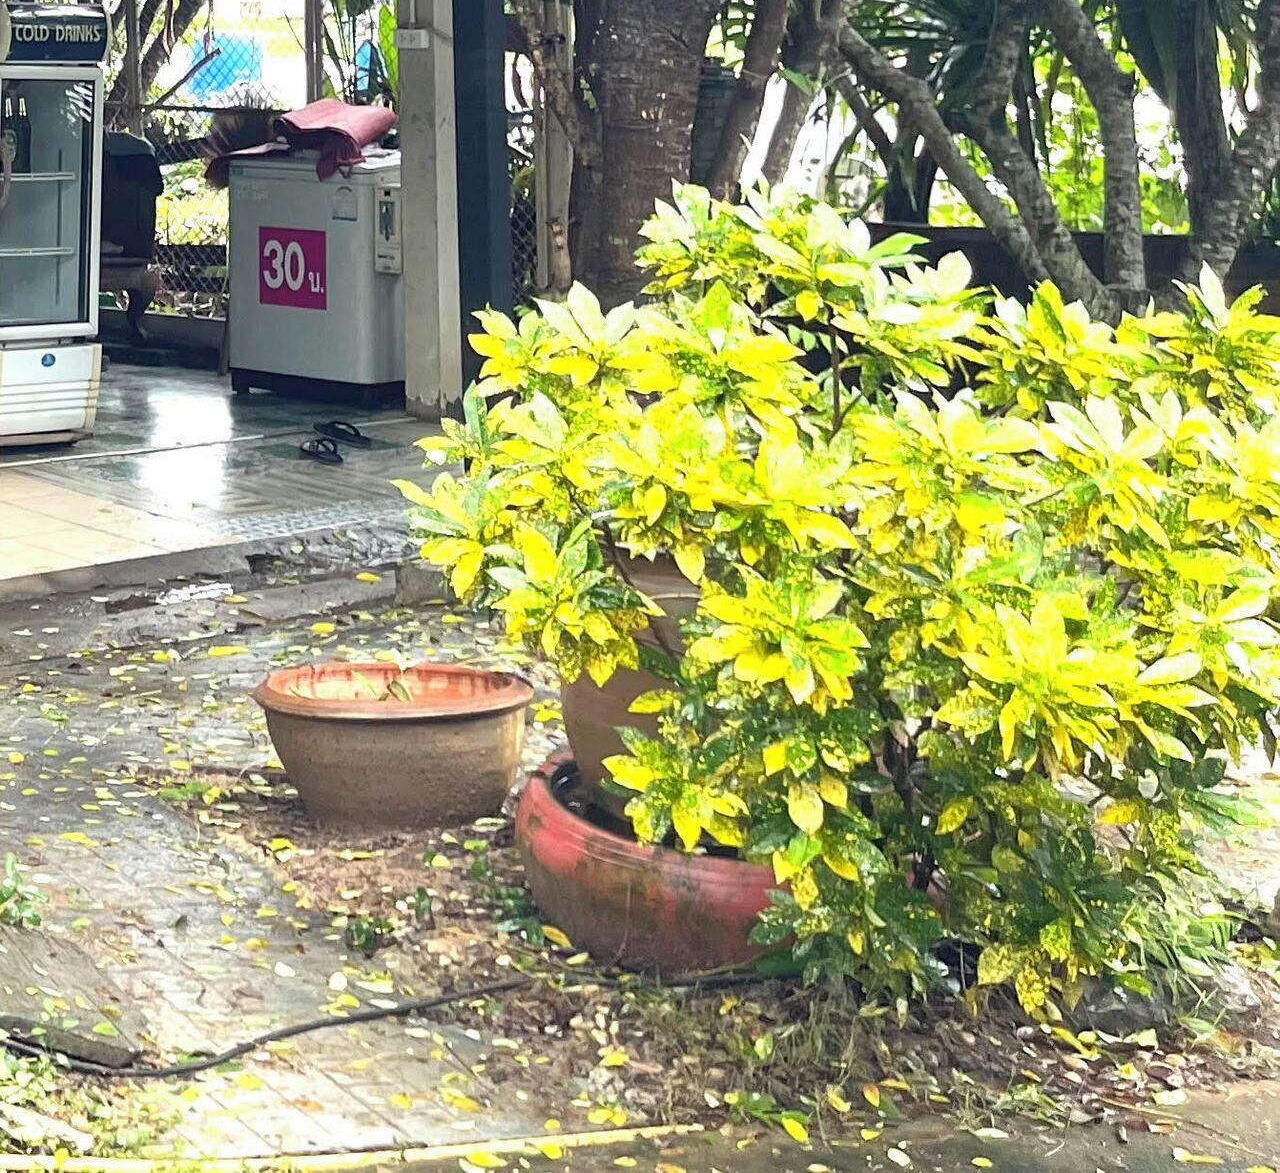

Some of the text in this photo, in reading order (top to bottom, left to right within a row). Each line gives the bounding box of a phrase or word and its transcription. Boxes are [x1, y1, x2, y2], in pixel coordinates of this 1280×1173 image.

[15, 24, 101, 42] COLD DRINKS
[263, 239, 325, 294] 30 บ.
